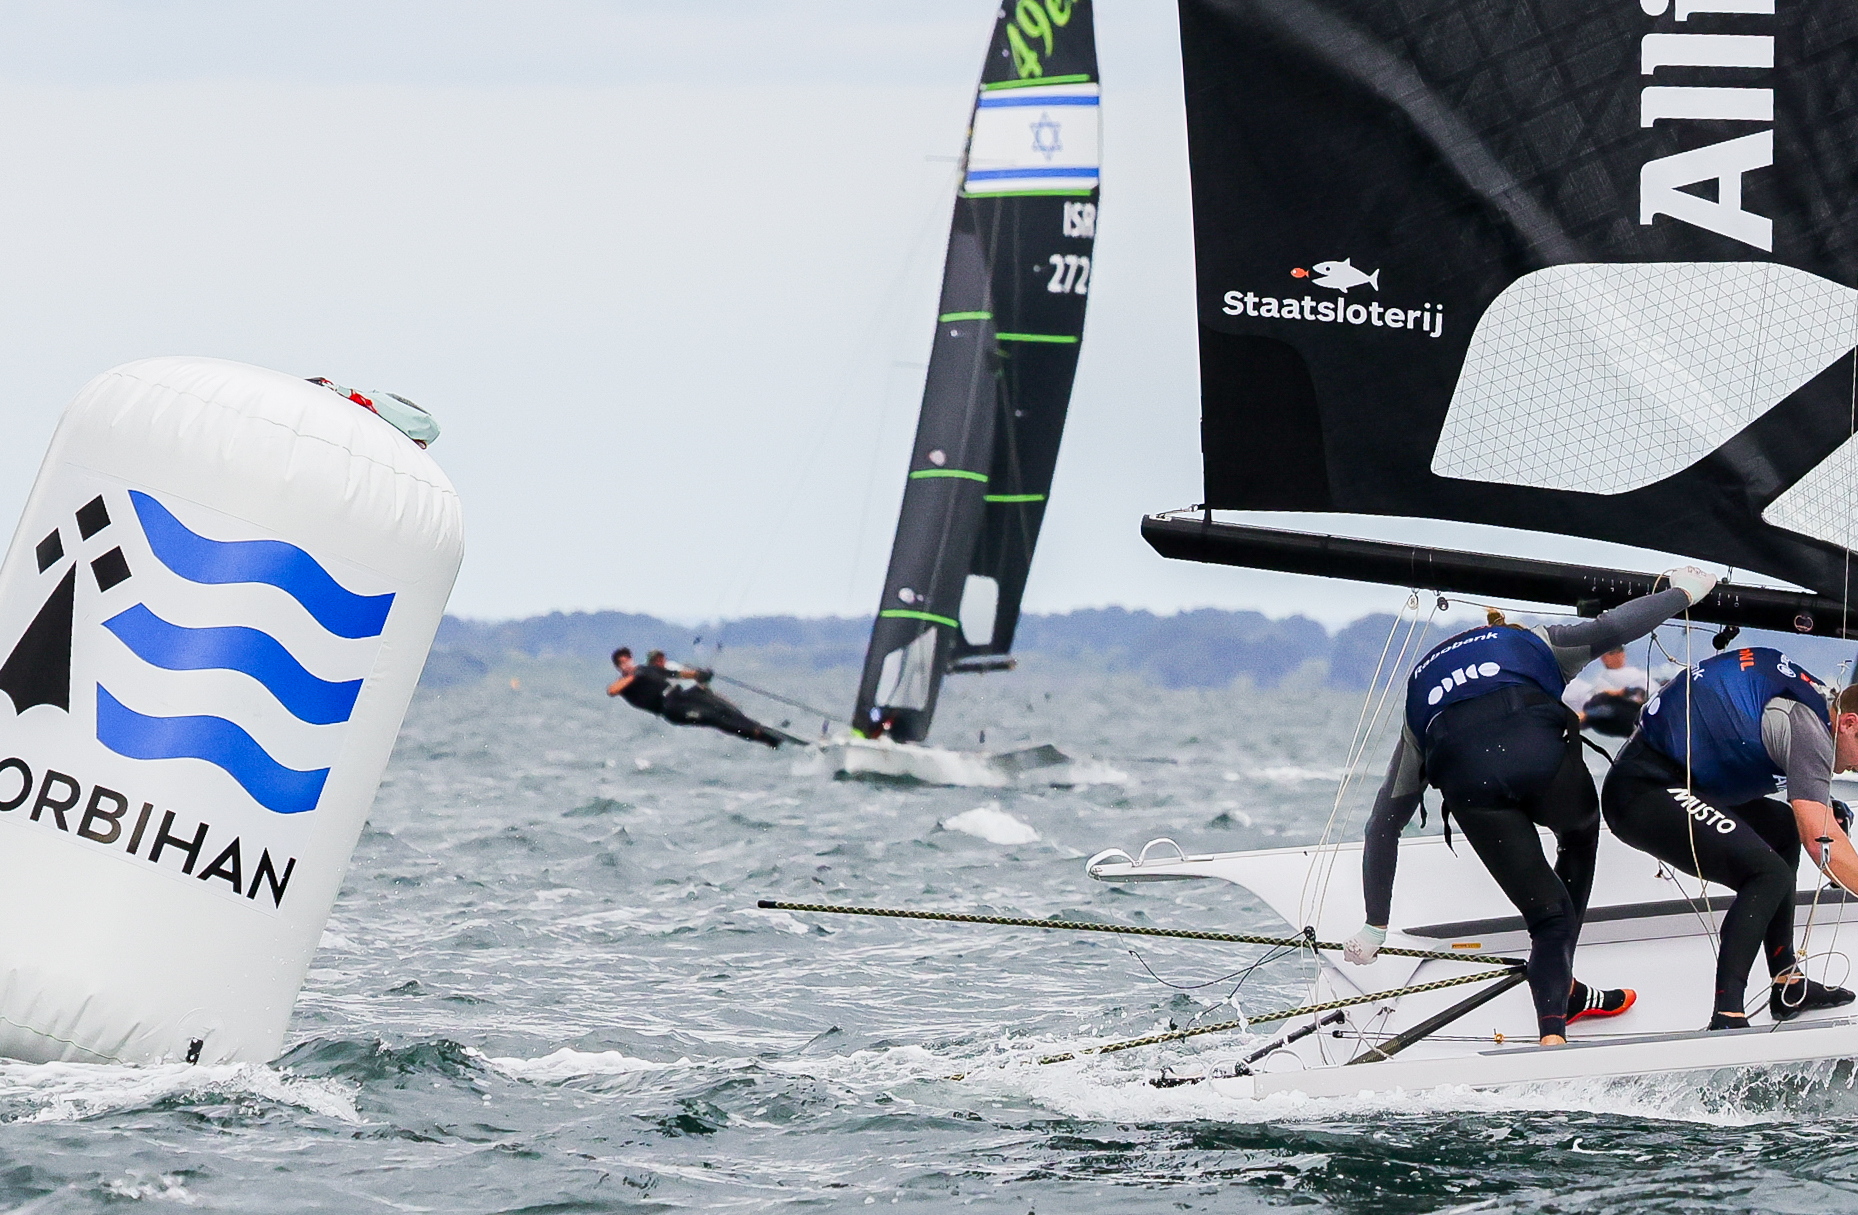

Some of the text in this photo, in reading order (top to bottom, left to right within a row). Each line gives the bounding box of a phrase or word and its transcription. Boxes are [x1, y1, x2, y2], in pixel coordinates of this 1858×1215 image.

[1063, 201, 1096, 238] ISR
[1047, 253, 1090, 295] 272
[1222, 290, 1444, 338] Staatsloterij
[1414, 632, 1498, 680] Rabobank
[0, 757, 296, 910] ORBIHAN
[1667, 788, 1737, 834] MUSTO
